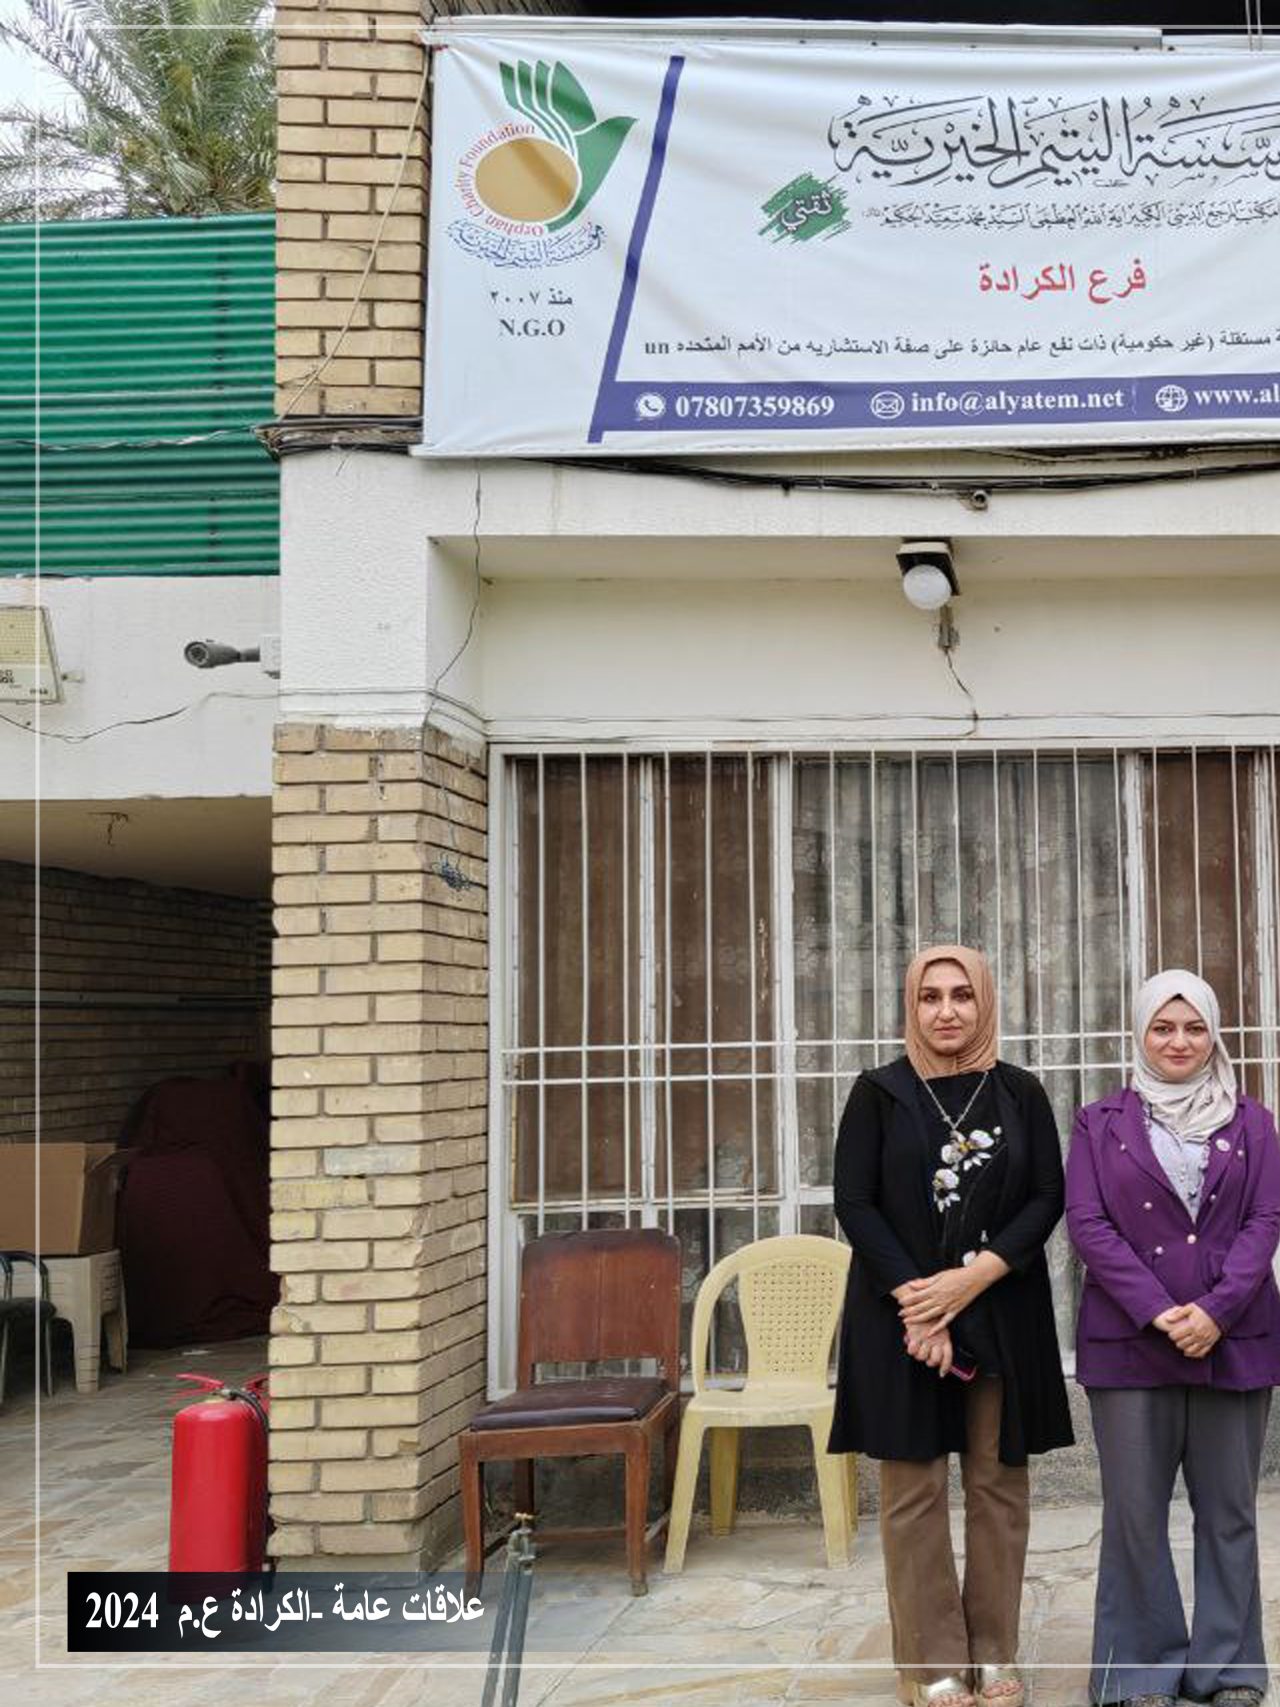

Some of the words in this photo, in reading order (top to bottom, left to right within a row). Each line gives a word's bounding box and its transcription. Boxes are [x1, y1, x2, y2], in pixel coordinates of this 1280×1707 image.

[460, 121, 535, 168] Foundation
[485, 214, 544, 237] Orphan
[979, 262, 1075, 300] الكرادة
[1089, 258, 1146, 304] فرع
[490, 289, 540, 305] ٢٠٠٧
[547, 288, 573, 305] منذ
[499, 318, 566, 337] N.G.O
[1219, 330, 1270, 346] مستقلة
[645, 341, 669, 354] un
[737, 332, 772, 359] الأمم
[777, 340, 801, 356] من
[894, 336, 930, 353] صفة
[934, 339, 964, 360] على
[970, 338, 1012, 357] حائزة
[1017, 338, 1042, 360] عام
[1049, 336, 1073, 358] نفع
[1078, 334, 1107, 351] ذات
[1111, 333, 1174, 356] حكومية)
[1181, 332, 1214, 353] (غير
[675, 394, 835, 418] 07807359869
[911, 389, 1125, 416] info@alyatem.net
